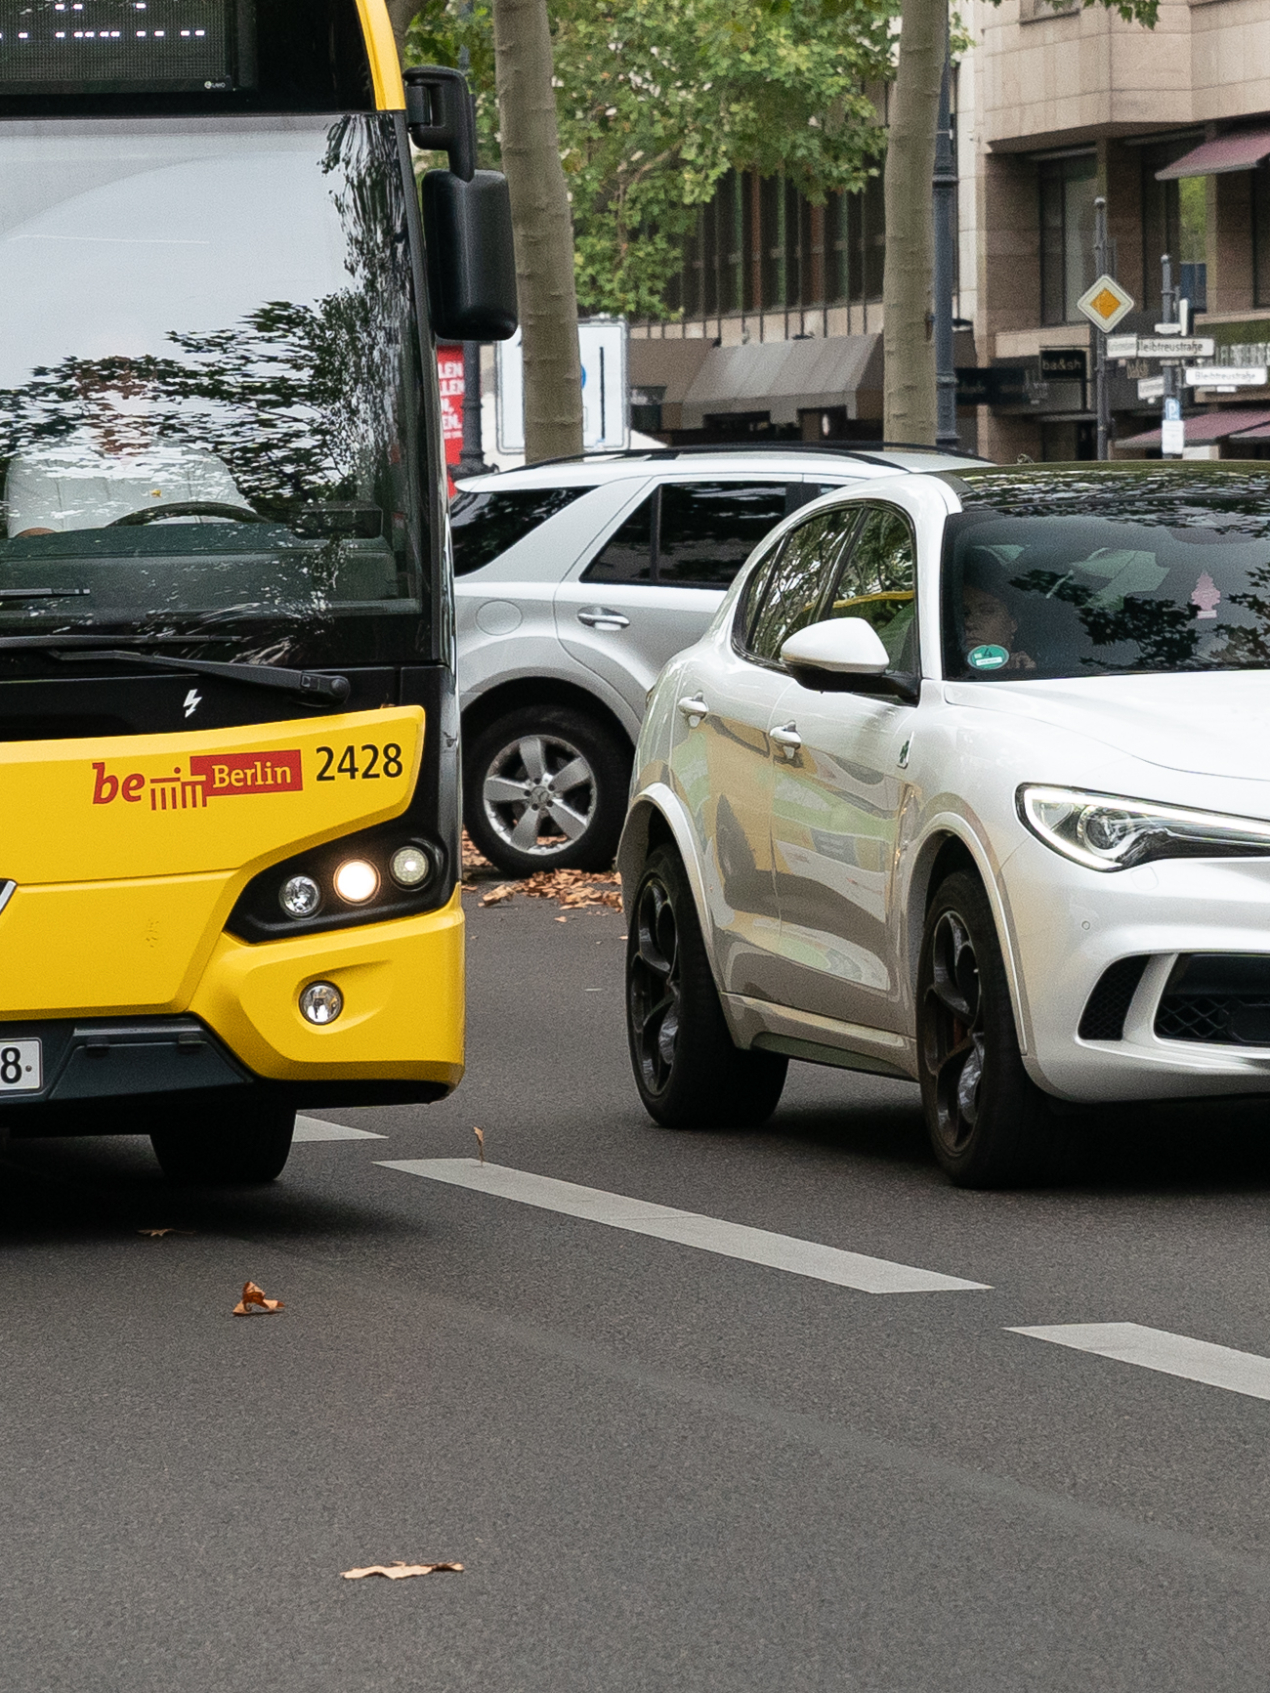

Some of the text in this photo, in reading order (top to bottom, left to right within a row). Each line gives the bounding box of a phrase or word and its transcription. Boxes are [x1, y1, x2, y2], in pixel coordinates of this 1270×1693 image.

[1042, 358, 1081, 370] ba&sh
[316, 743, 403, 781] 2428
[92, 761, 292, 804] be Berlin
